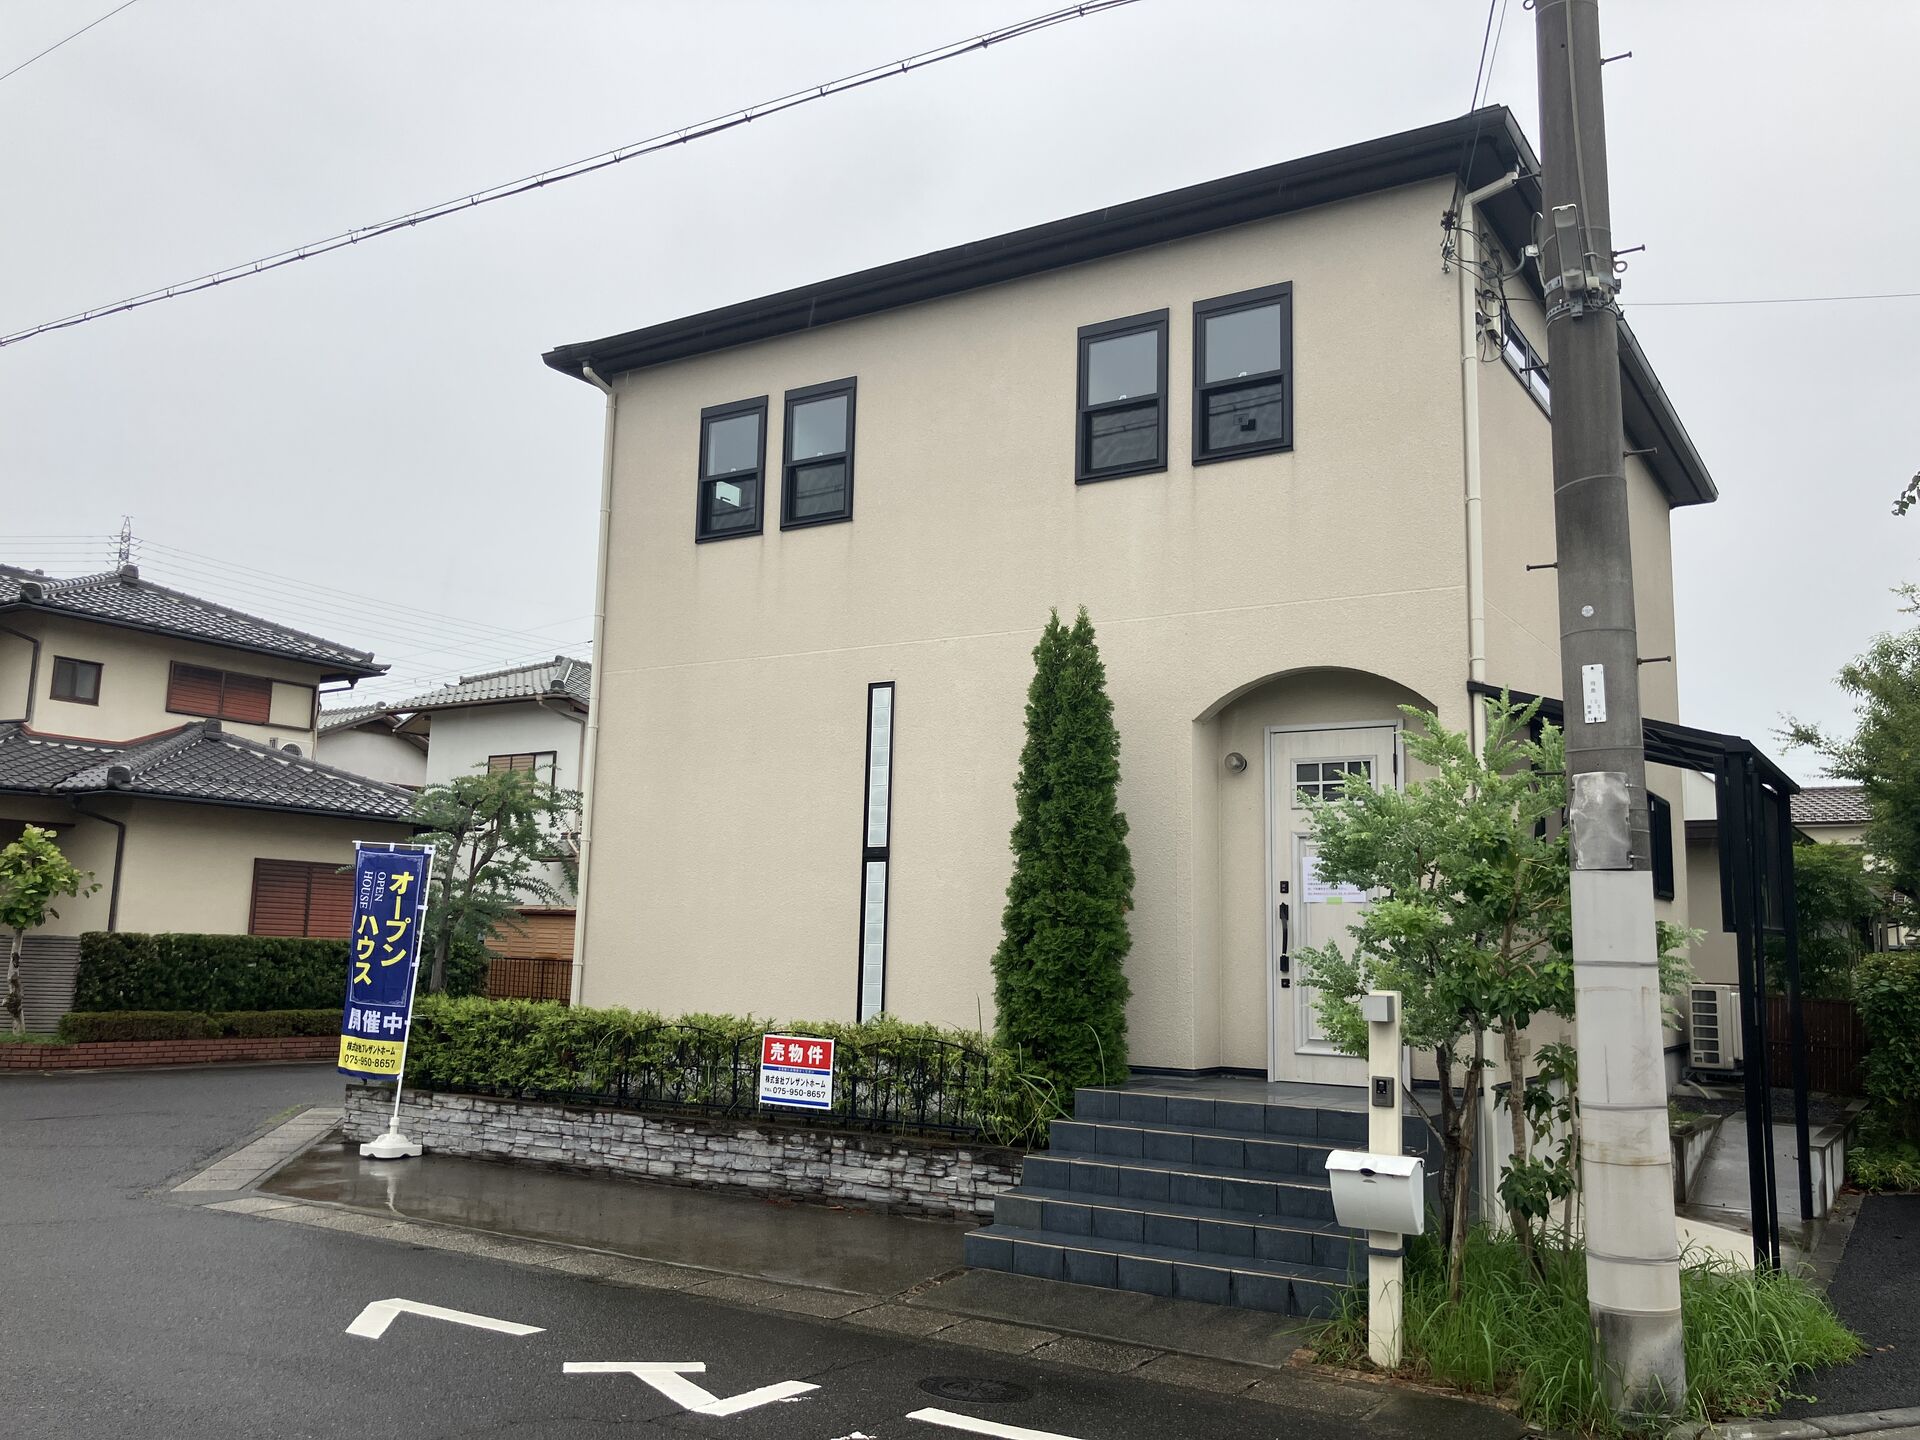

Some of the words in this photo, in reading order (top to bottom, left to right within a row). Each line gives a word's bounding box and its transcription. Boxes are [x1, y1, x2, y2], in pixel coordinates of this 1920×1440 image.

[360, 870, 373, 909] HOUSE
[375, 872, 387, 902] OPEN
[381, 871, 414, 967] オープン
[354, 915, 379, 985] ハウス
[348, 1007, 403, 1035] 開催中
[344, 1054, 396, 1069] 075-950-8657
[770, 1042, 823, 1064] 売物件
[772, 1087, 826, 1099] 075-950-8657
